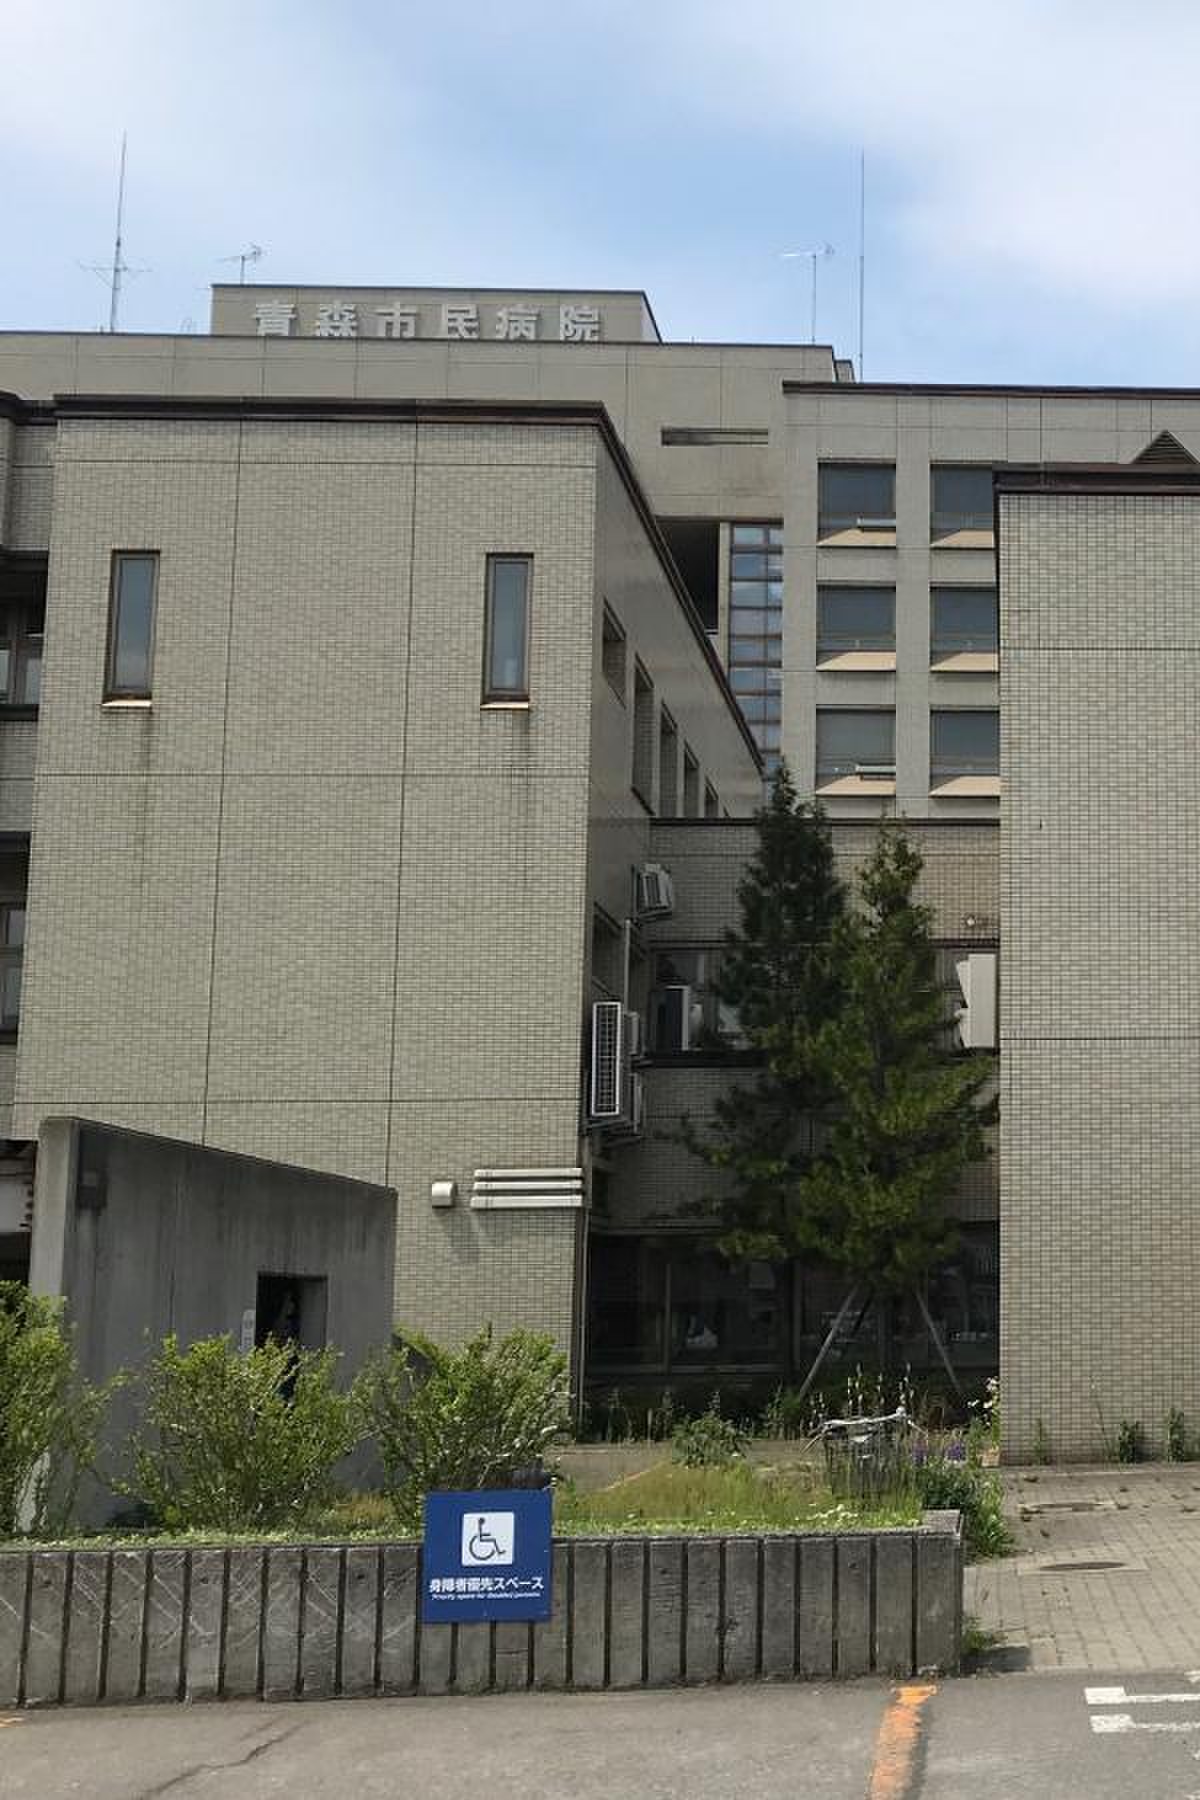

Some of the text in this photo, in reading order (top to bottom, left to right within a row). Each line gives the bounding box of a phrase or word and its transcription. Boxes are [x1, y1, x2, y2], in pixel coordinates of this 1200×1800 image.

[252, 301, 601, 341] 青森市民病院
[429, 1576, 544, 1593] 身障者優先スペース
